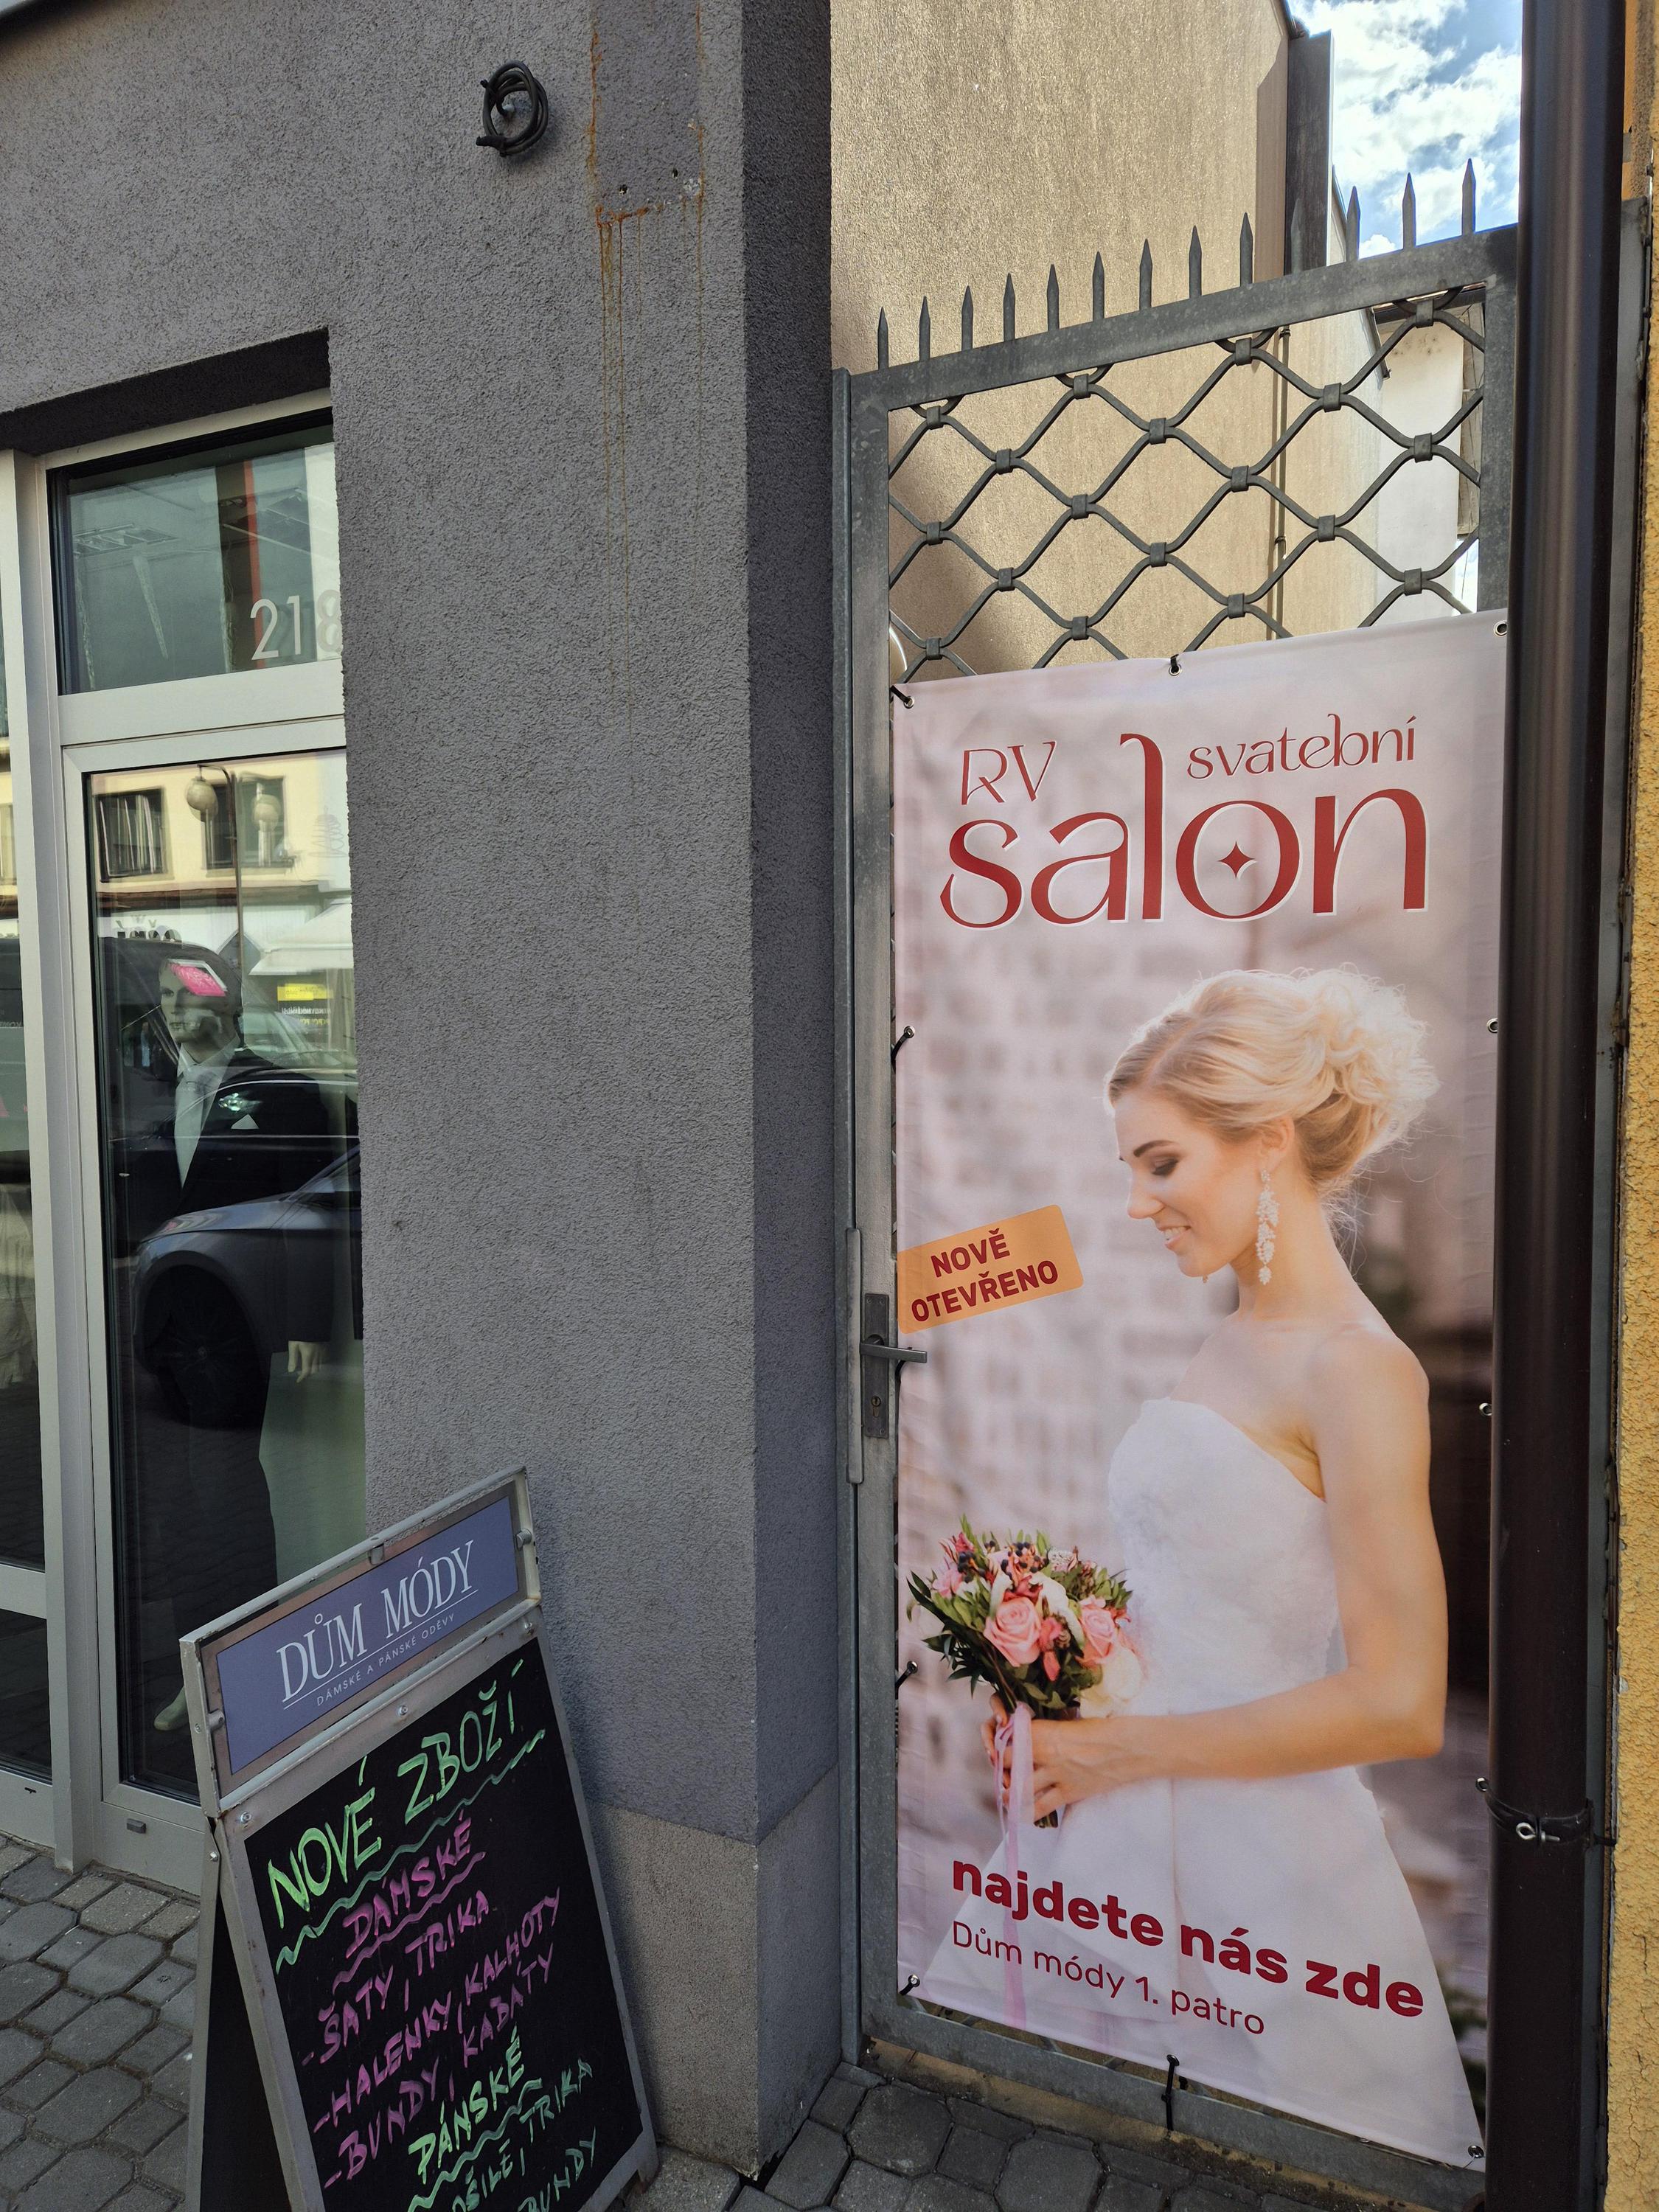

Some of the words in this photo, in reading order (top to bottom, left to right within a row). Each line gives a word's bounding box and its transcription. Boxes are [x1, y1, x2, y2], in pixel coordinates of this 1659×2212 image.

[250, 590, 342, 660] 218
[961, 740, 1057, 805] RV
[1187, 713, 1416, 779] svatební
[940, 733, 1428, 929] salon
[911, 1260, 1058, 1322] OTEVŘENO
[931, 1228, 1010, 1278] NOVĚ
[276, 1602, 367, 1703] DŮM
[380, 1540, 473, 1638] MÓDY
[317, 1670, 361, 1706] DÁMSKÉ
[366, 1664, 374, 1674] A
[378, 1636, 417, 1667] PÁNSKÉ
[421, 1613, 455, 1639] ODĚVY
[268, 1756, 382, 1929] NOVÉ
[397, 1659, 524, 1826] ZBOŽÍ
[342, 1809, 472, 1959] DÁMSKÉ
[405, 1889, 489, 1977] TRIKA
[465, 1886, 560, 2006] KALHOTY
[952, 1860, 1164, 1947] najdete
[1180, 1927, 1288, 1983] nás
[1304, 1959, 1424, 2017] zde
[953, 1921, 1022, 1965] Dům
[1034, 1955, 1125, 1999] módy
[1135, 1976, 1159, 2004] 1.
[1172, 1988, 1265, 2035] patro
[408, 2025, 525, 2185] PÁNSKÉ
[519, 2058, 593, 2143] TRIKA
